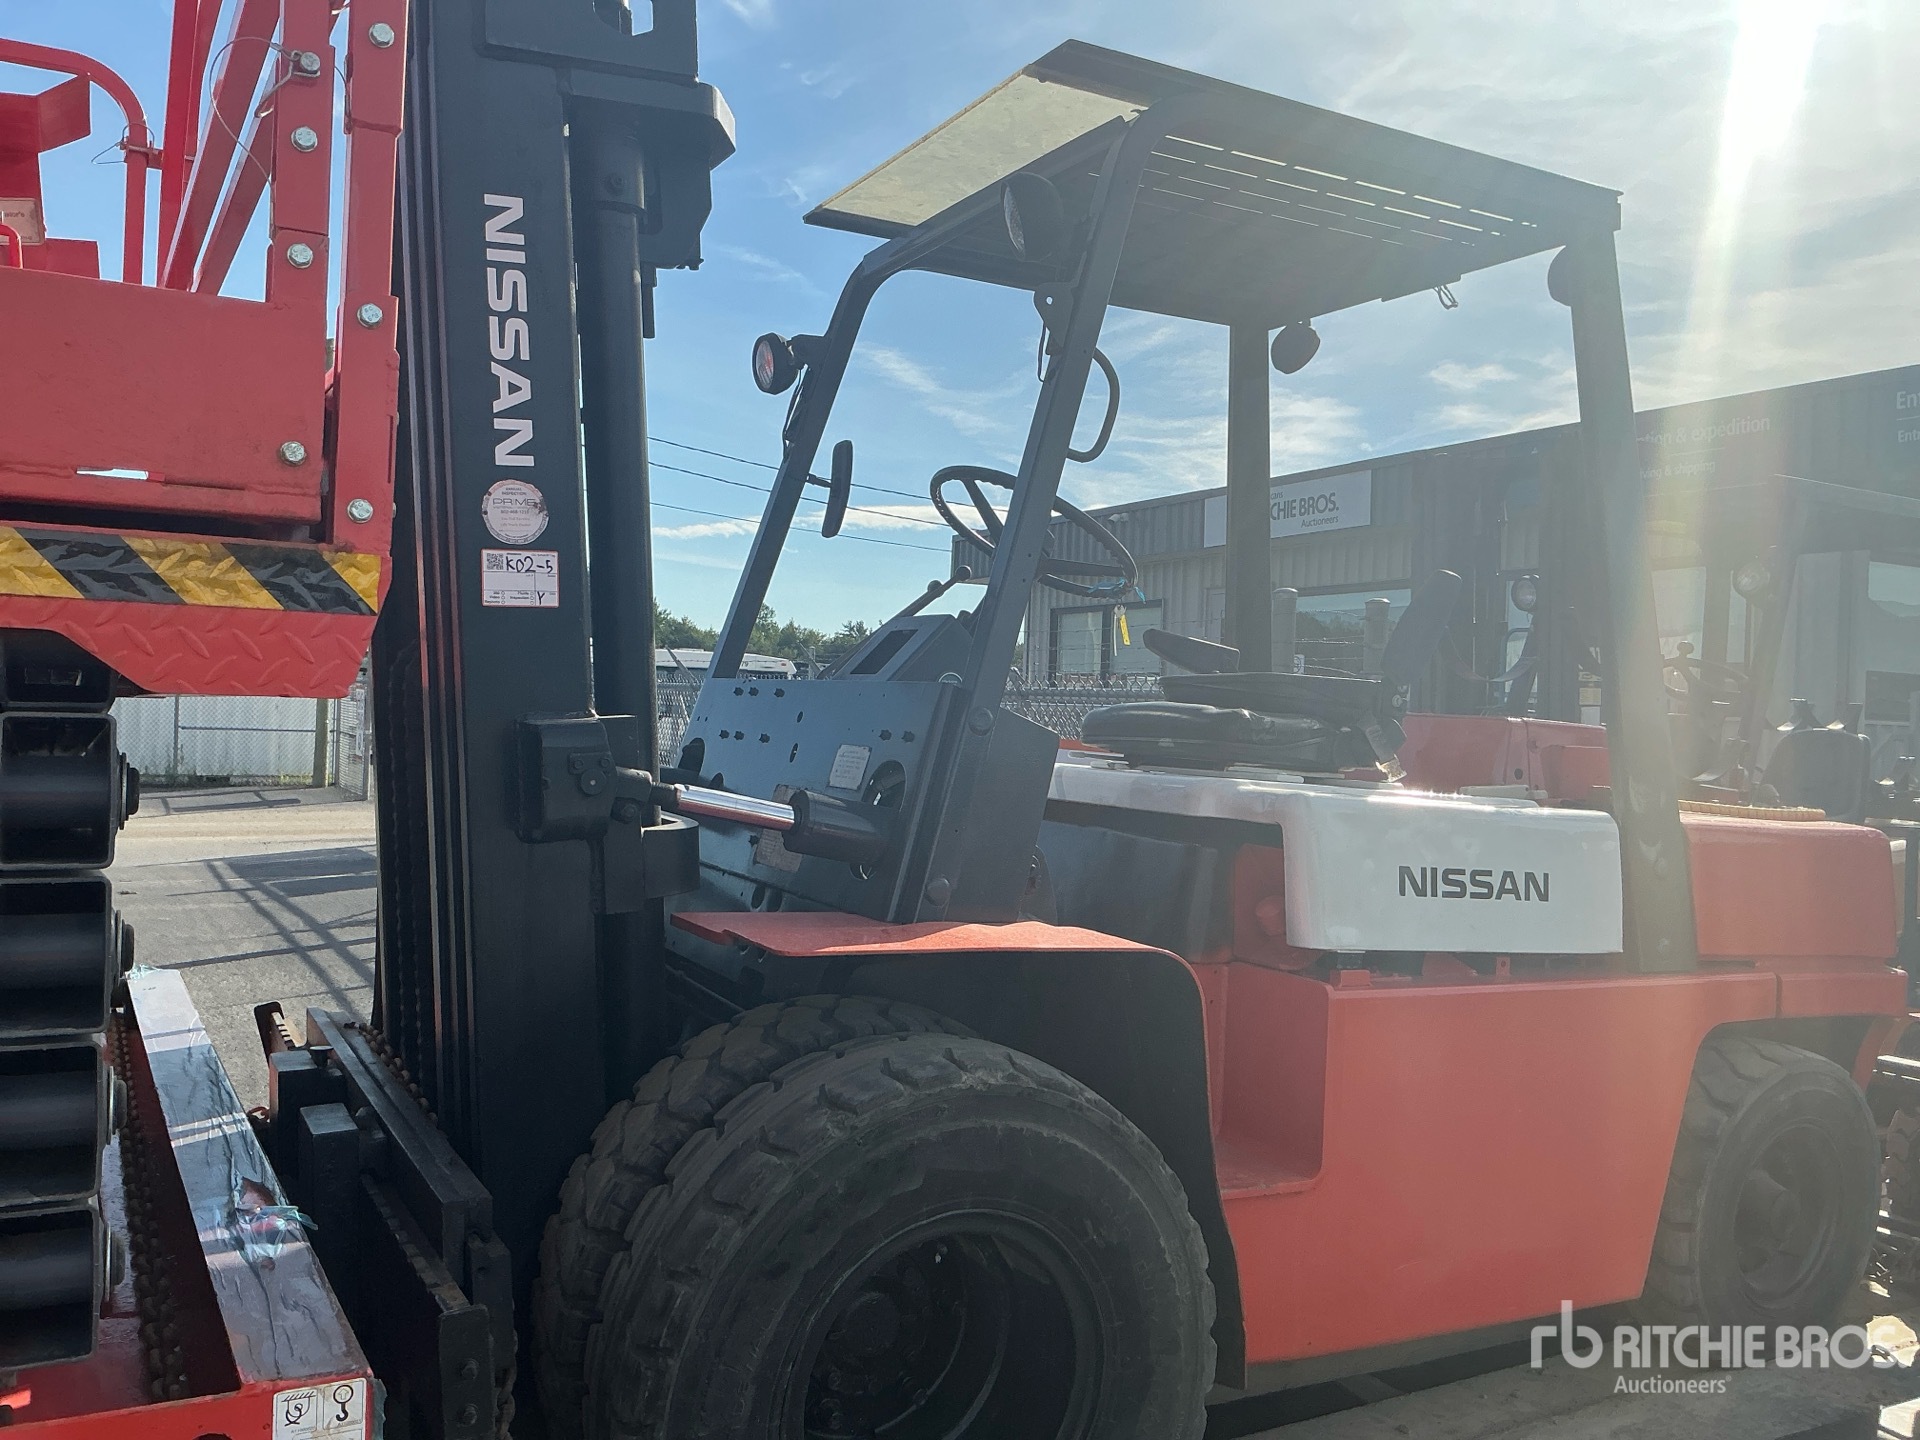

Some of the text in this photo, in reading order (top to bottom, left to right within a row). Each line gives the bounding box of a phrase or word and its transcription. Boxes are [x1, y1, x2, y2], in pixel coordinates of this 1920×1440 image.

[484, 194, 535, 467] NISSAN
[1270, 491, 1284, 500] cans
[1270, 492, 1339, 521] CHIE BROS.
[1301, 515, 1339, 529] Auctioneers
[506, 556, 553, 574] K02-5
[537, 591, 545, 605] Y
[1399, 866, 1549, 902] NISSAN
